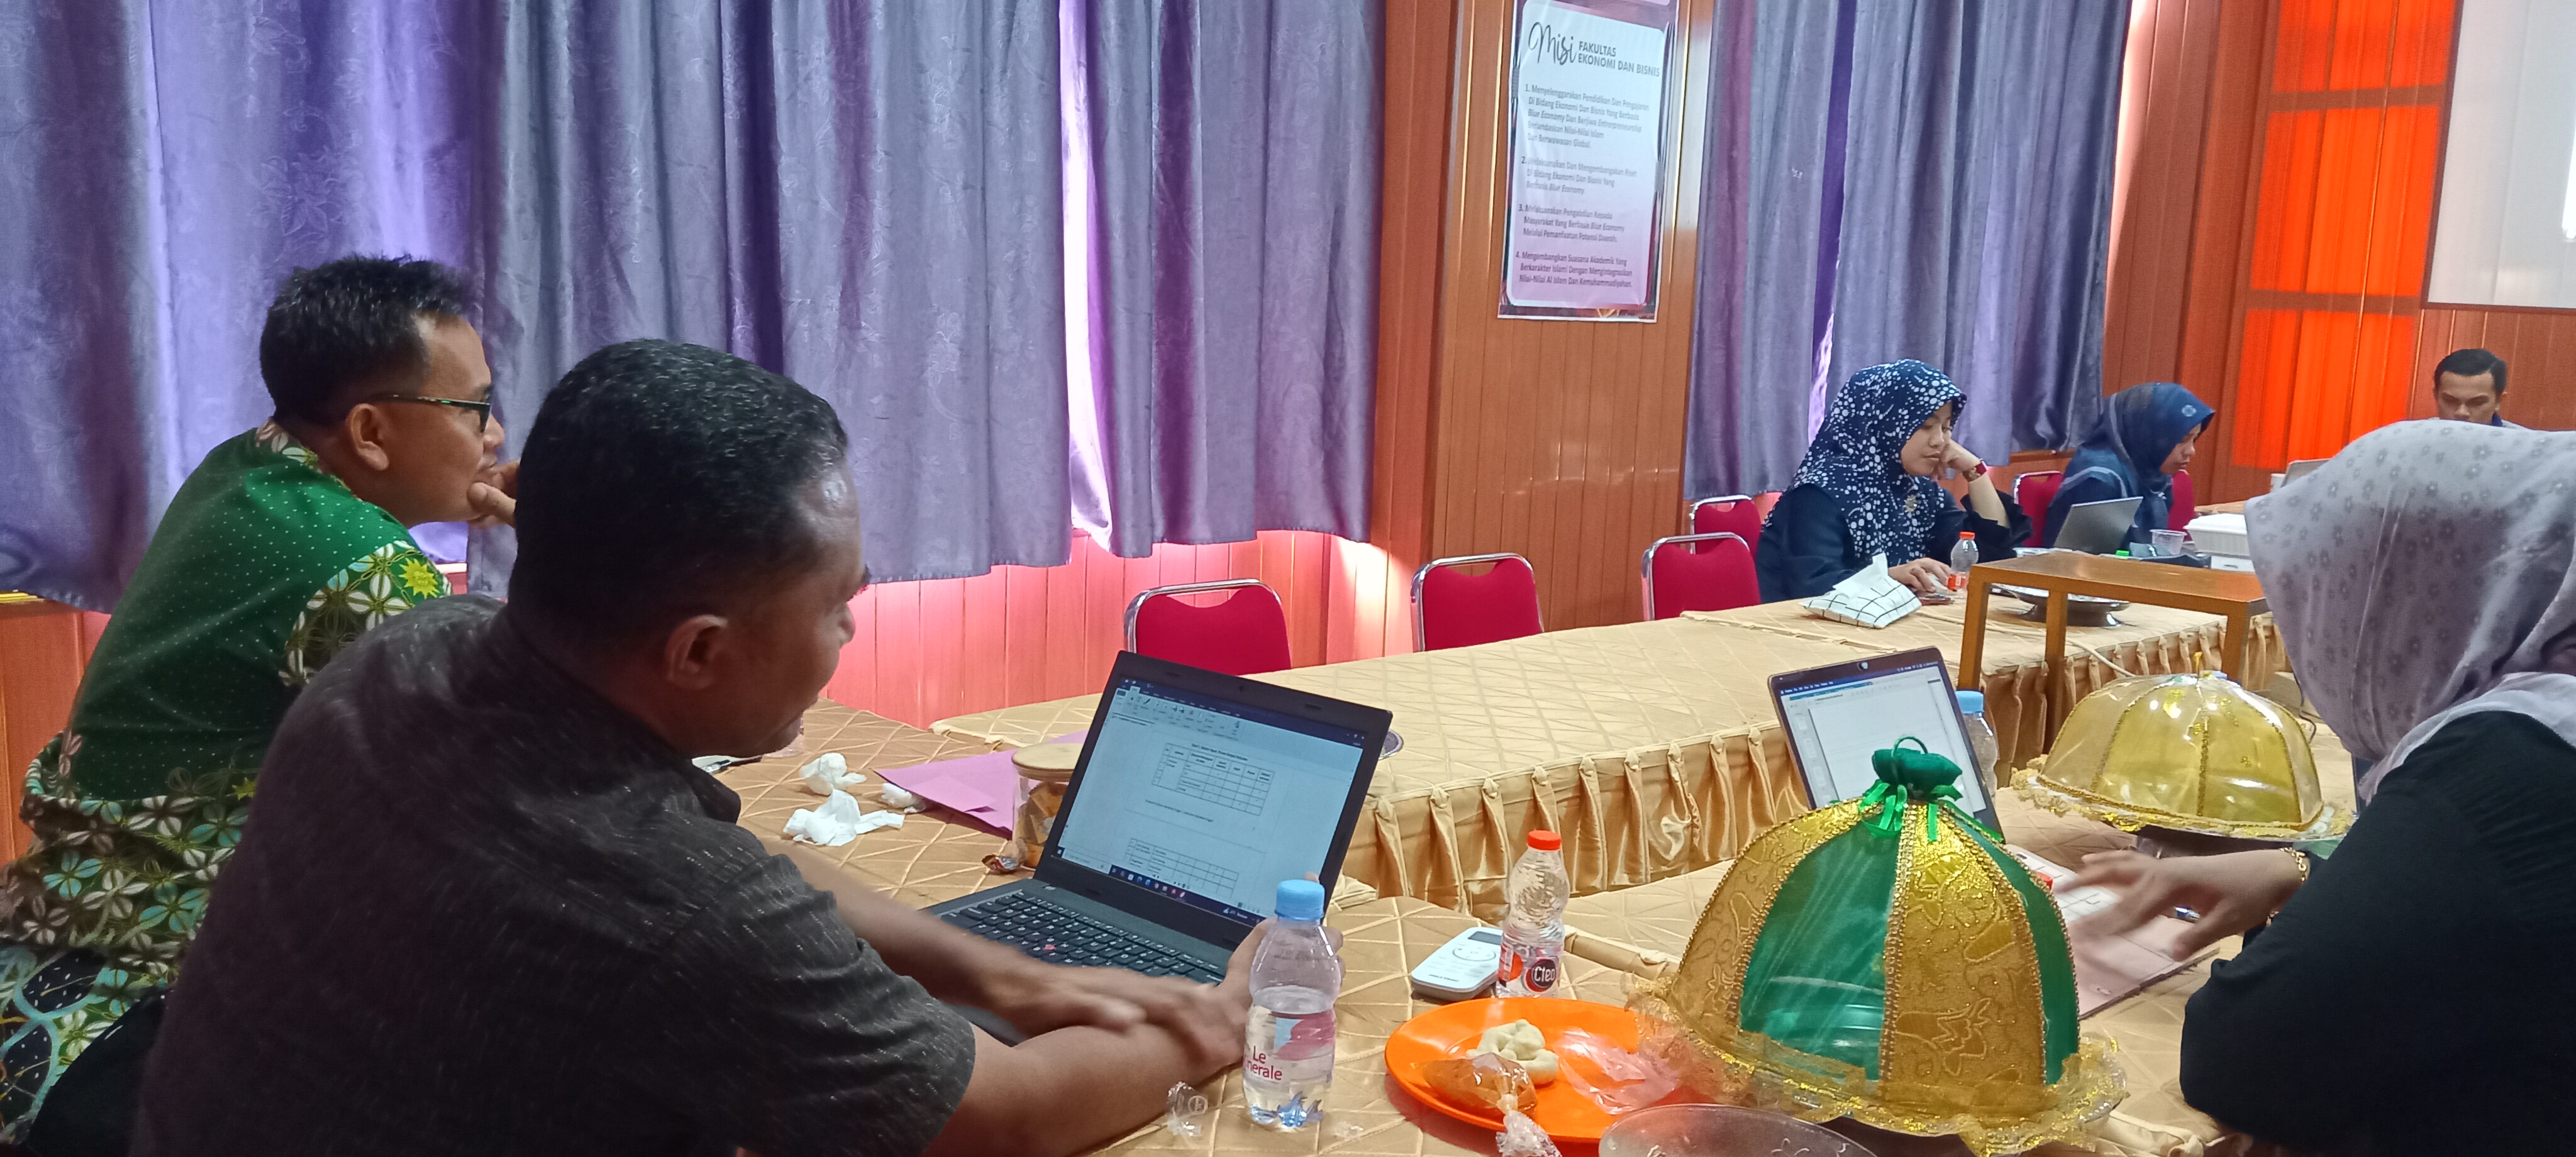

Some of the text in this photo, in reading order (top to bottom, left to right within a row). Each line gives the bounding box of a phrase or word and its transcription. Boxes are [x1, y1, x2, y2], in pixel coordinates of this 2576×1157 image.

[1528, 22, 1577, 65] Misi
[1579, 41, 1616, 57] FAKULTAS
[1578, 53, 1660, 77] EKONOMI DAN BISNIS
[1525, 84, 1530, 92] 1.
[1583, 93, 1611, 105] Pendidikan
[1611, 97, 1622, 106] Dan
[1528, 97, 1535, 105] Di
[1536, 97, 1554, 110] Bidang
[1555, 101, 1578, 111] Ekonomi
[1579, 104, 1589, 113] Dan
[1591, 106, 1605, 116] Bisnis
[1606, 109, 1618, 119] Yang
[1528, 108, 1540, 118] Blue
[1541, 110, 1565, 123] Economy
[1566, 114, 1577, 123] Dan
[1578, 116, 1597, 126] Berjiwa
[1539, 134, 1573, 147] Berwawasan
[1591, 129, 1604, 138] Islam
[1521, 156, 1527, 164] 2.
[1566, 162, 1577, 170] Dan
[1534, 169, 1552, 180] Bidang
[1552, 171, 1575, 182] Ekonomi
[1576, 174, 1587, 182] Dan
[1603, 178, 1615, 188] Yang
[1519, 204, 1524, 212] 3.
[1555, 219, 1567, 229] Yang
[1591, 222, 1602, 230] Blue
[1602, 223, 1625, 234] Economy
[1579, 232, 1598, 241] Potensi
[1520, 263, 1552, 272] Berkarakter
[1568, 266, 1588, 275] Dengan
[1615, 257, 1628, 267] Yang
[1553, 276, 1568, 285] Islam
[1568, 277, 1579, 285] Dan
[1253, 1046, 1266, 1064] Le
[1246, 1060, 1282, 1081] nerale
